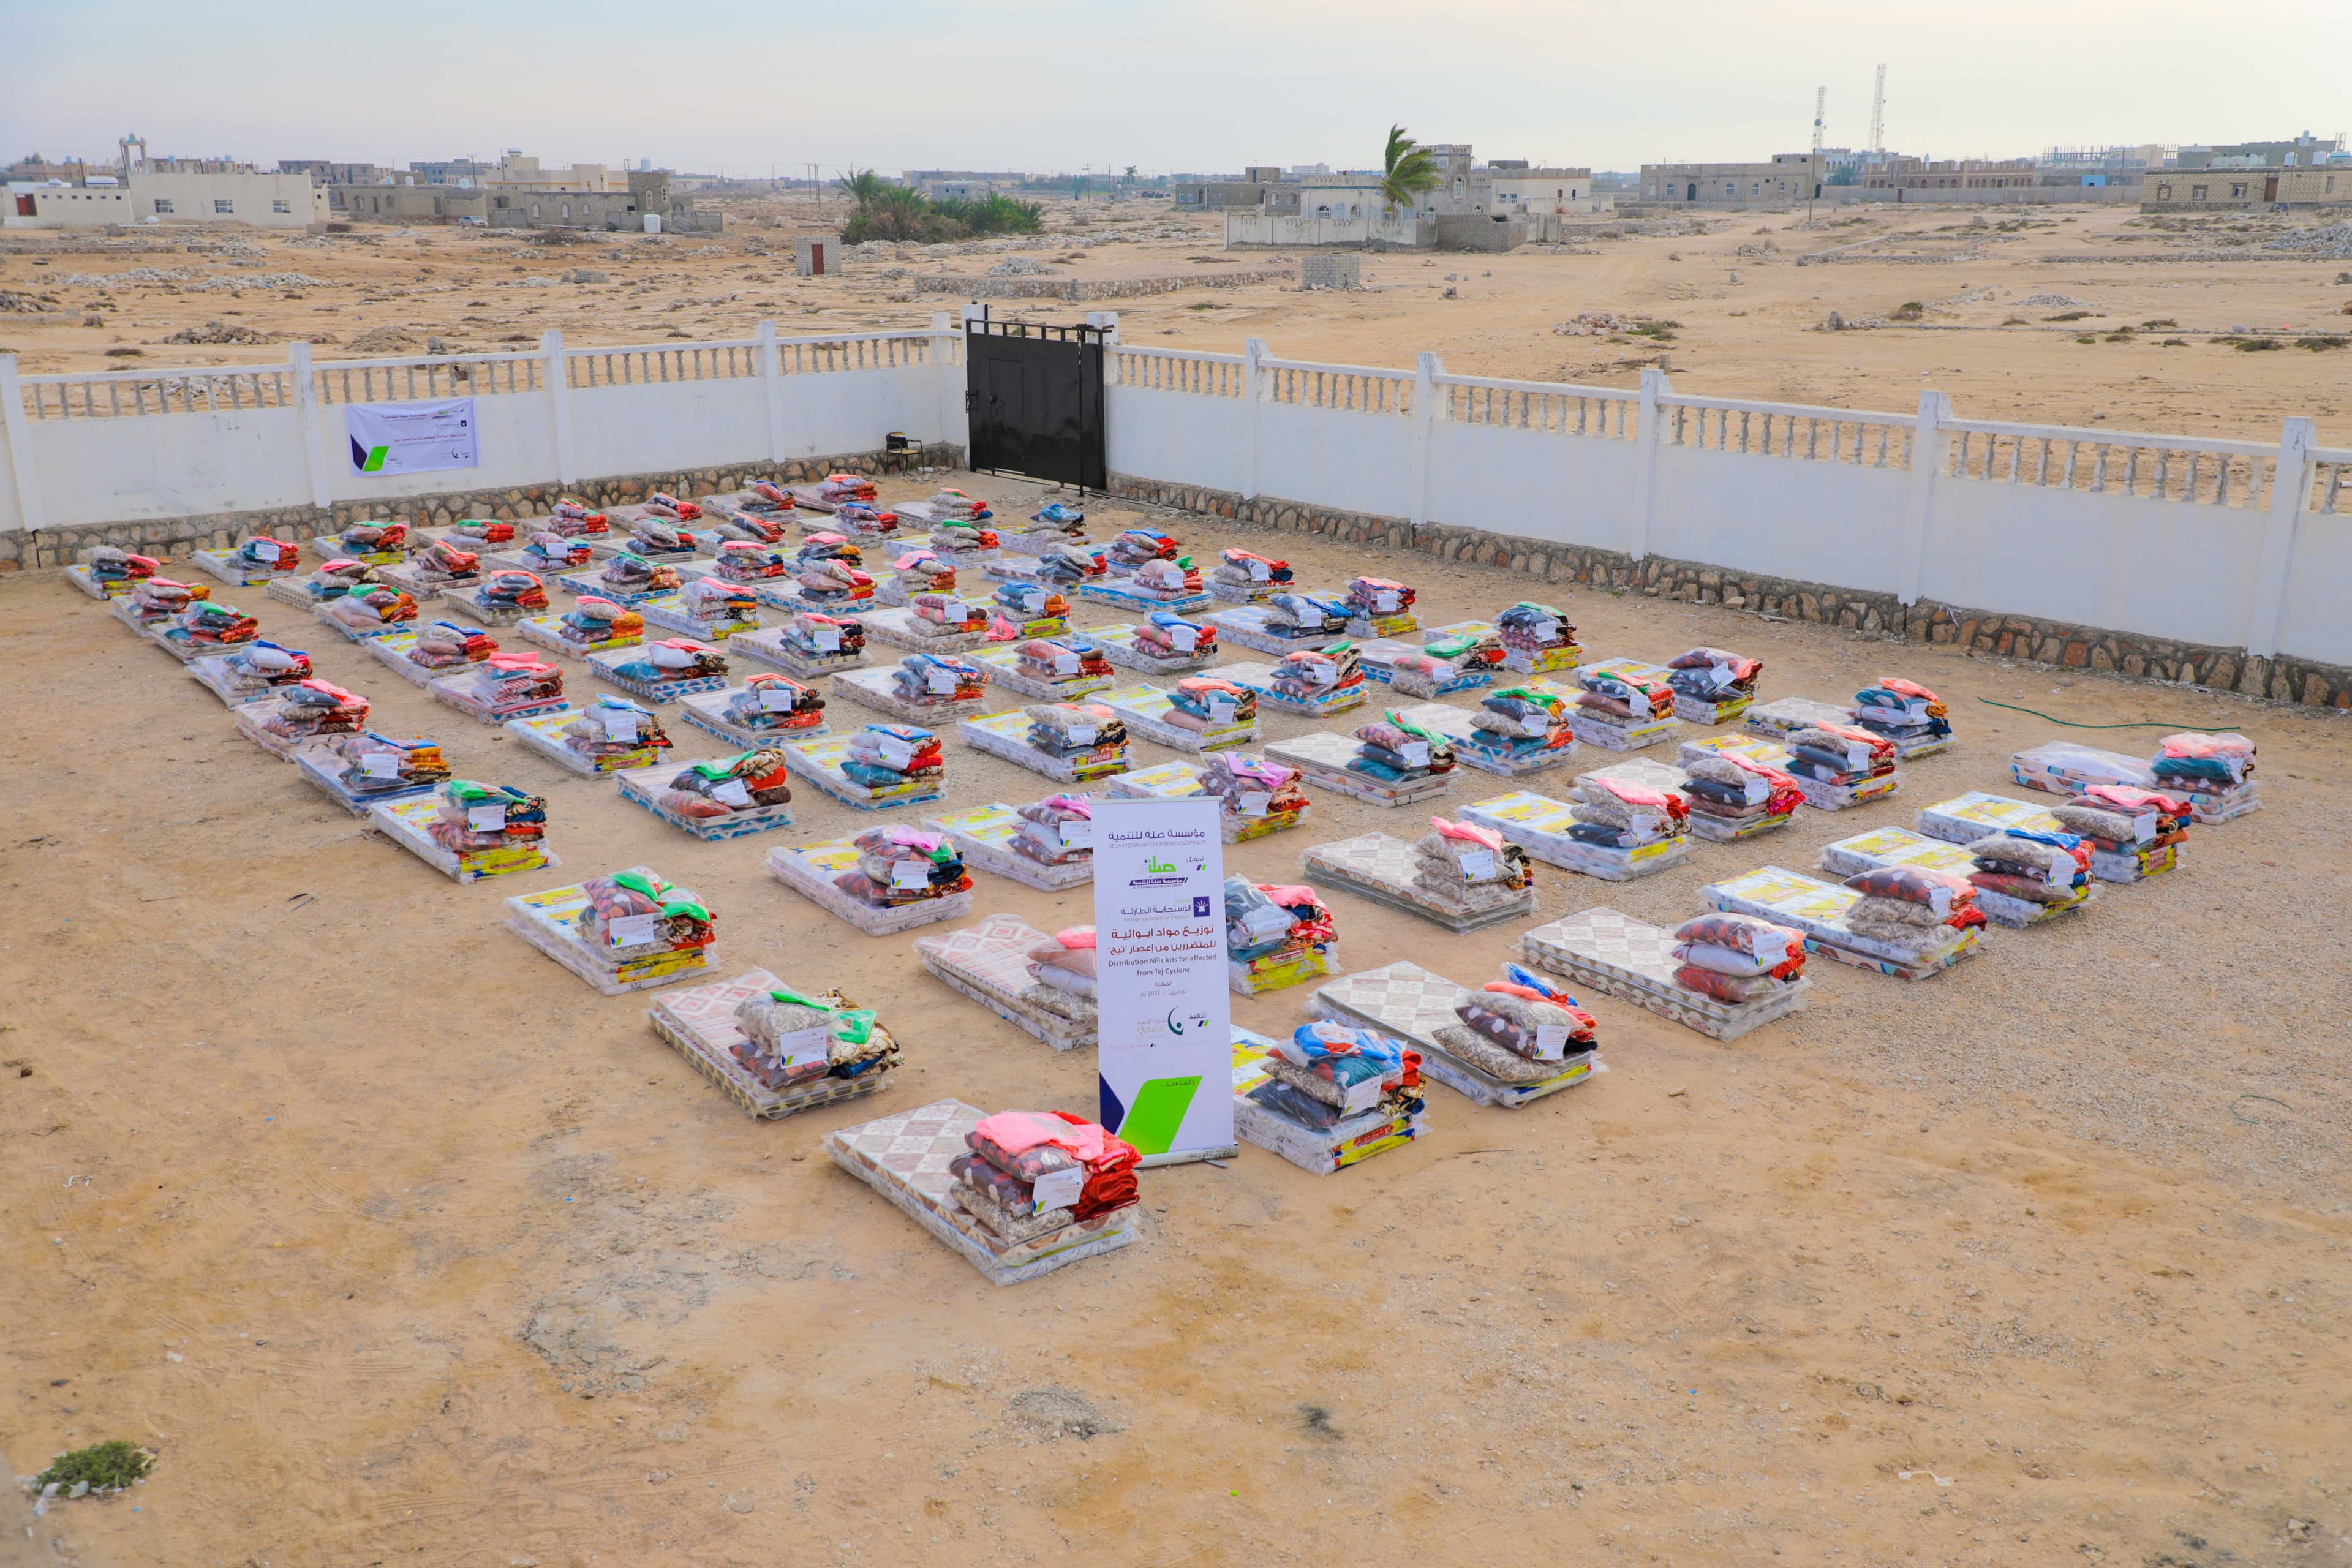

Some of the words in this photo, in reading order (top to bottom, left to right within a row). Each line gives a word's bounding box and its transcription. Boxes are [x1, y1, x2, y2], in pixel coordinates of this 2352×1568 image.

[1108, 831, 1142, 842] للتنمية
[1145, 829, 1165, 839] صلة
[1167, 828, 1205, 838] مؤسسة
[1120, 907, 1152, 916] الطارئة
[1156, 927, 1180, 937] مواد
[1182, 924, 1214, 936] توزيع
[1129, 944, 1154, 954] إعصار
[1155, 943, 1169, 952] من
[1171, 940, 1216, 951] للمتضررين
[1108, 958, 1148, 967] Distribution
[1155, 968, 1164, 976] Tej
[1165, 967, 1191, 975] Cyclone
